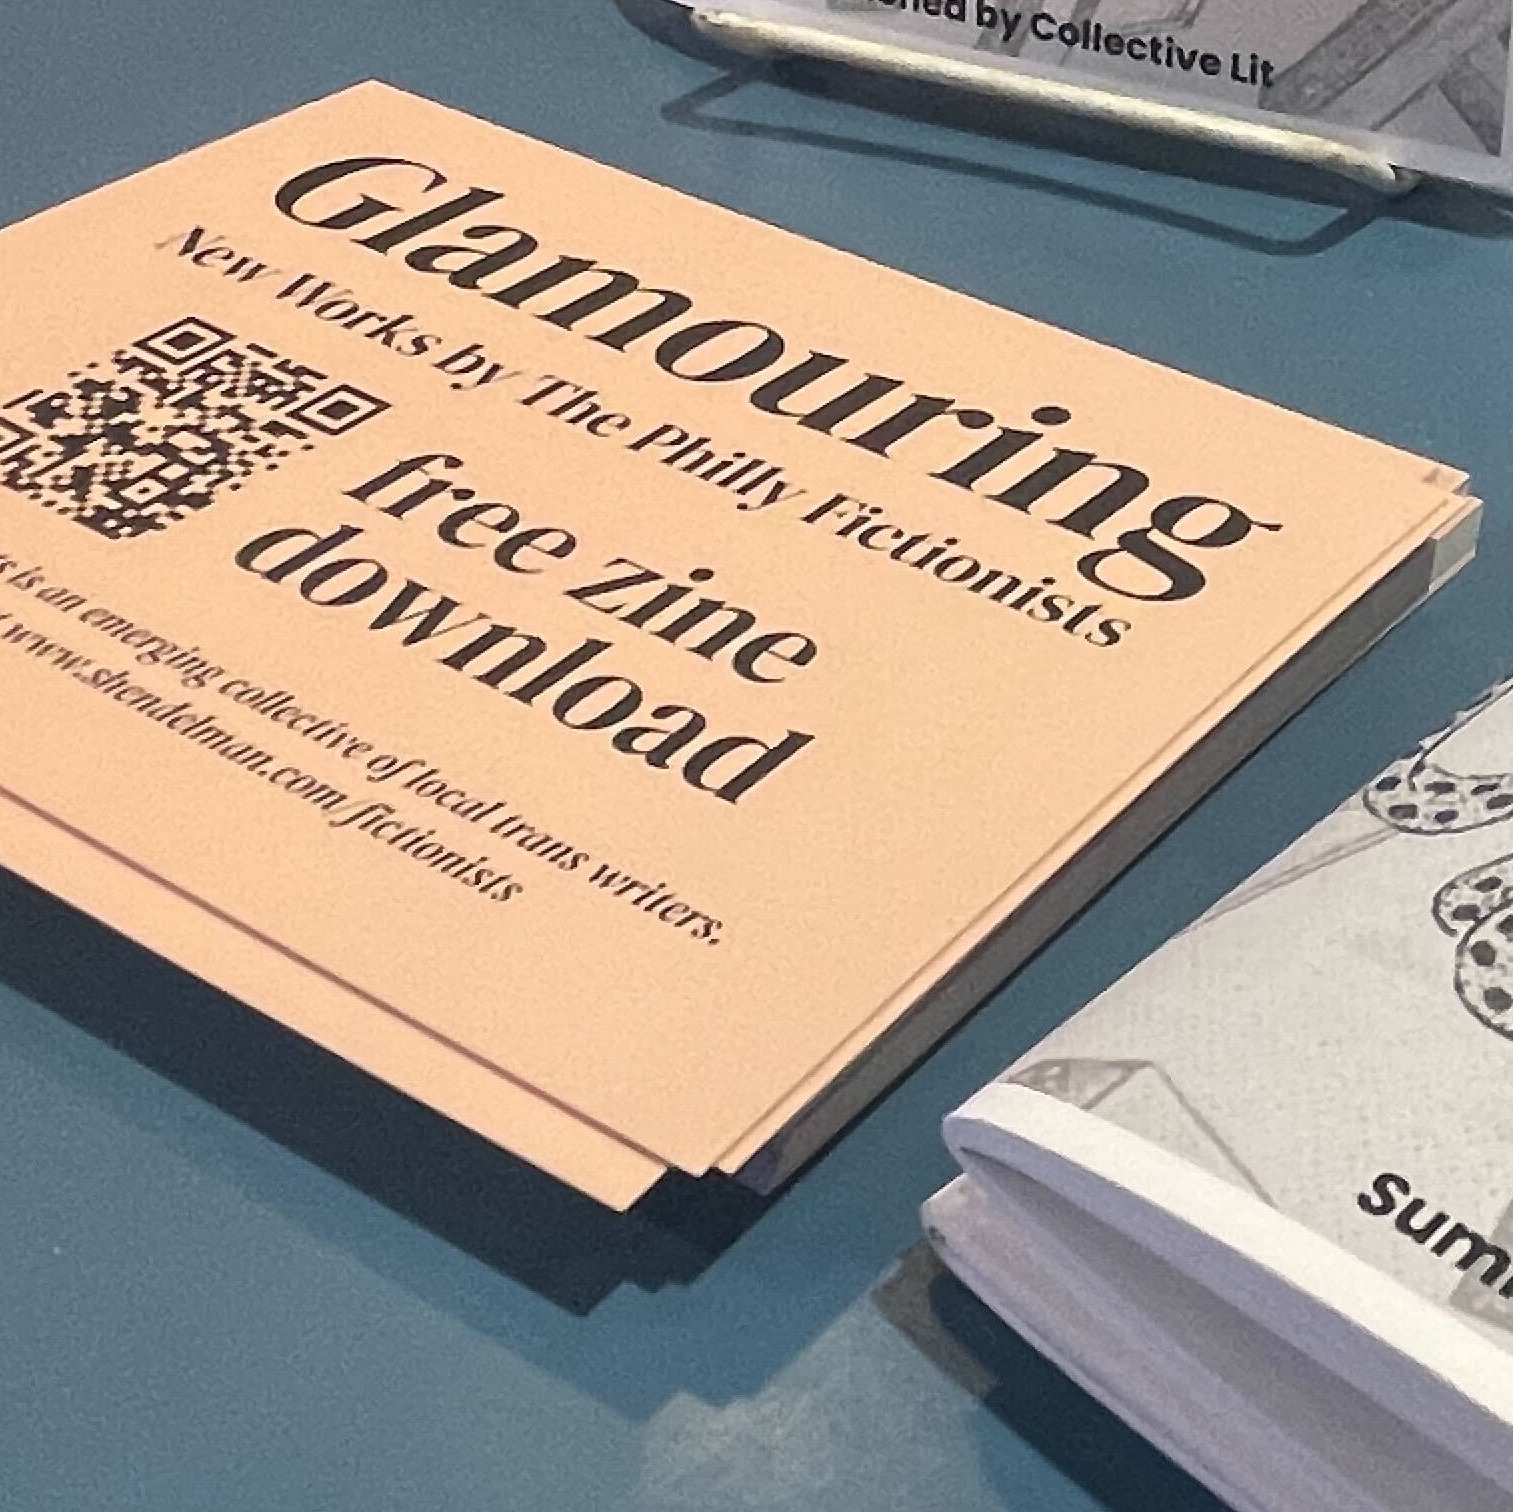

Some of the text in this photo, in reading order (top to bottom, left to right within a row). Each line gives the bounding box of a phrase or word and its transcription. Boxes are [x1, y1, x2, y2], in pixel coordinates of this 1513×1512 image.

[1031, 11, 1221, 75] Collective
[1230, 52, 1275, 88] Lit
[155, 225, 1132, 648] New Works by The Philly Fictionists
[273, 155, 1283, 603] Glamouring
[234, 523, 816, 806] download
[342, 452, 818, 684] free zine
[1, 622, 525, 902] www.shendelman.com/fictionists
[7, 565, 724, 946] is an emerging collective of local trans writers.
